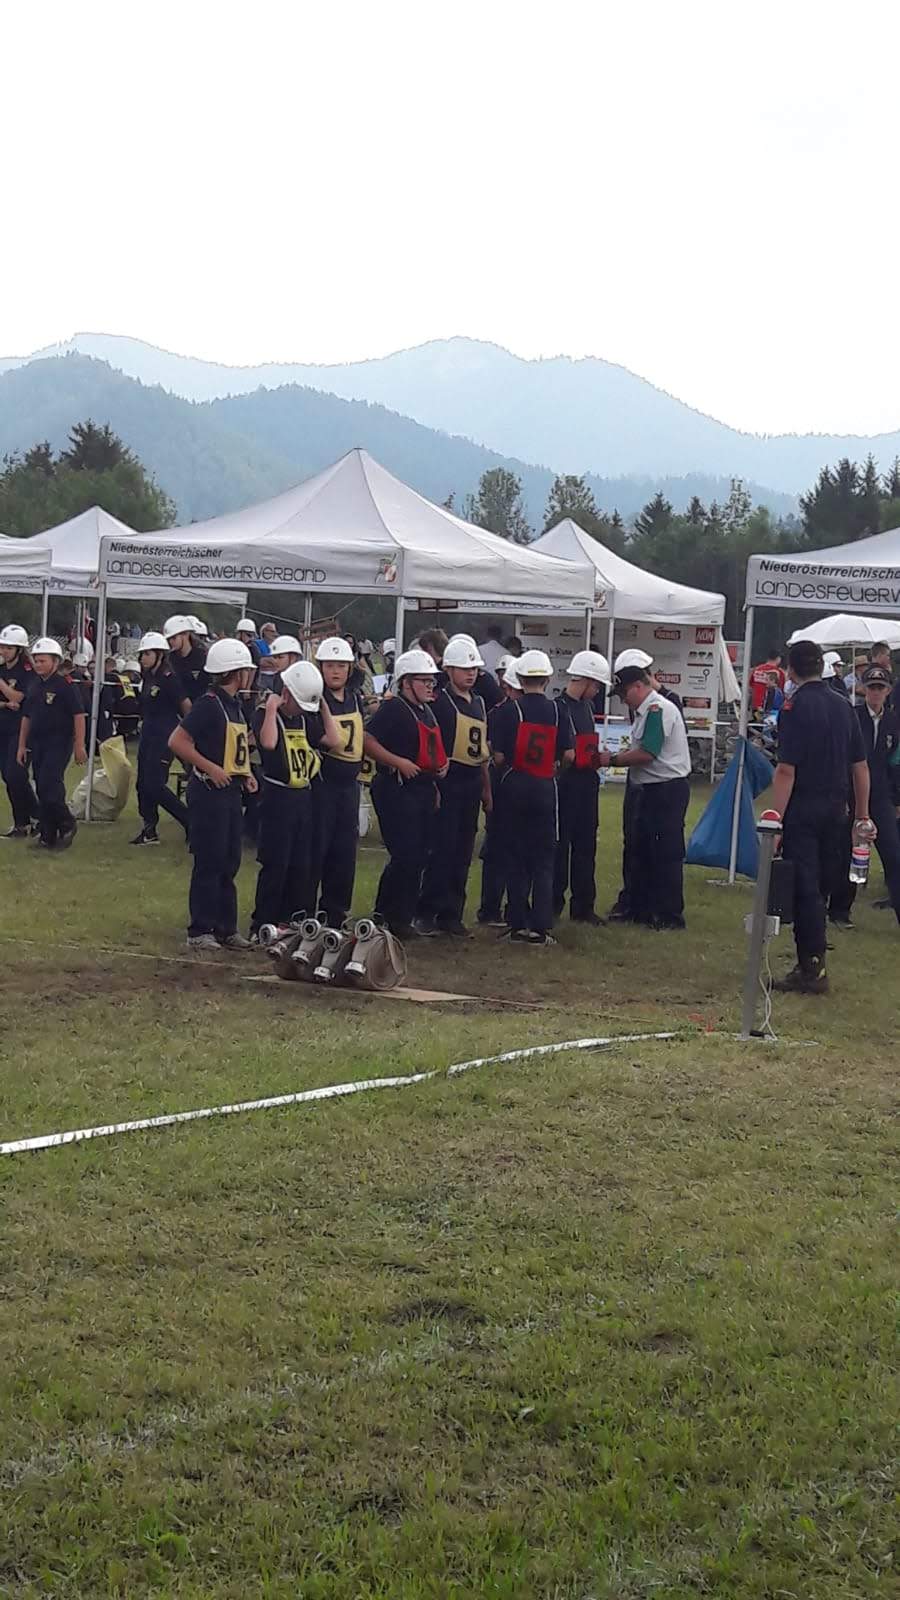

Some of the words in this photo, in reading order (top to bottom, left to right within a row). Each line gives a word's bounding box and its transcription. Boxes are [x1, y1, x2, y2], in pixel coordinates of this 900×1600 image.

[109, 541, 223, 559] Niederösterreichischer
[235, 732, 247, 766] 6
[340, 720, 355, 752] 7
[467, 727, 481, 758] 9
[525, 732, 547, 766] 5
